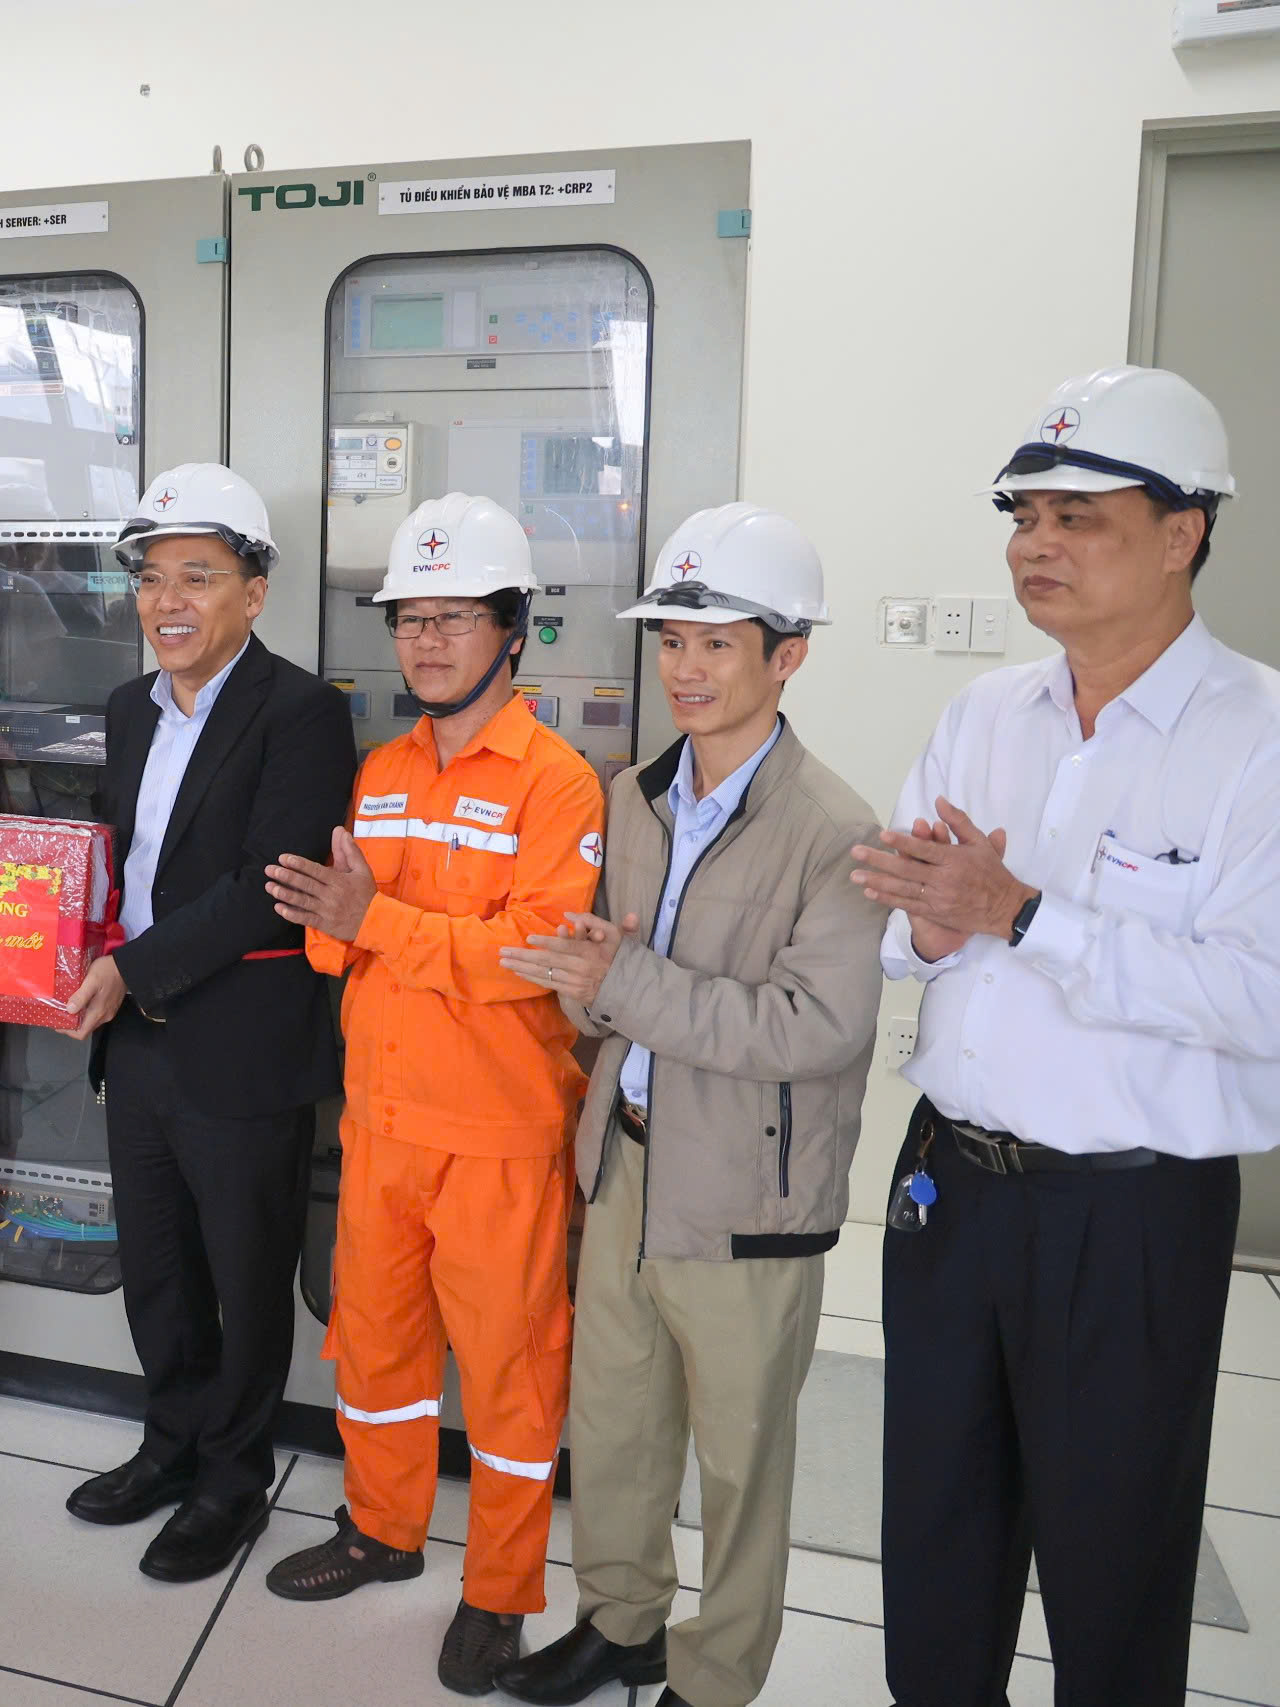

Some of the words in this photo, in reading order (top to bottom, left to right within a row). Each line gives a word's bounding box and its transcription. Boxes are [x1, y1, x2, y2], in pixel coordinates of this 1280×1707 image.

[238, 180, 364, 212] TOJI
[400, 187, 412, 203] TỦ
[414, 187, 438, 203] ĐIỀU
[440, 184, 471, 201] KHIỂN
[473, 183, 495, 200] BẢO
[497, 184, 510, 200] VỆ
[512, 185, 536, 197] MBA
[539, 184, 554, 196] T2:
[557, 182, 593, 195] +CRP2
[5, 216, 41, 228] SERVER:
[43, 214, 67, 225] +SER
[413, 562, 451, 573] EVNCPC
[4, 931, 45, 950] mới
